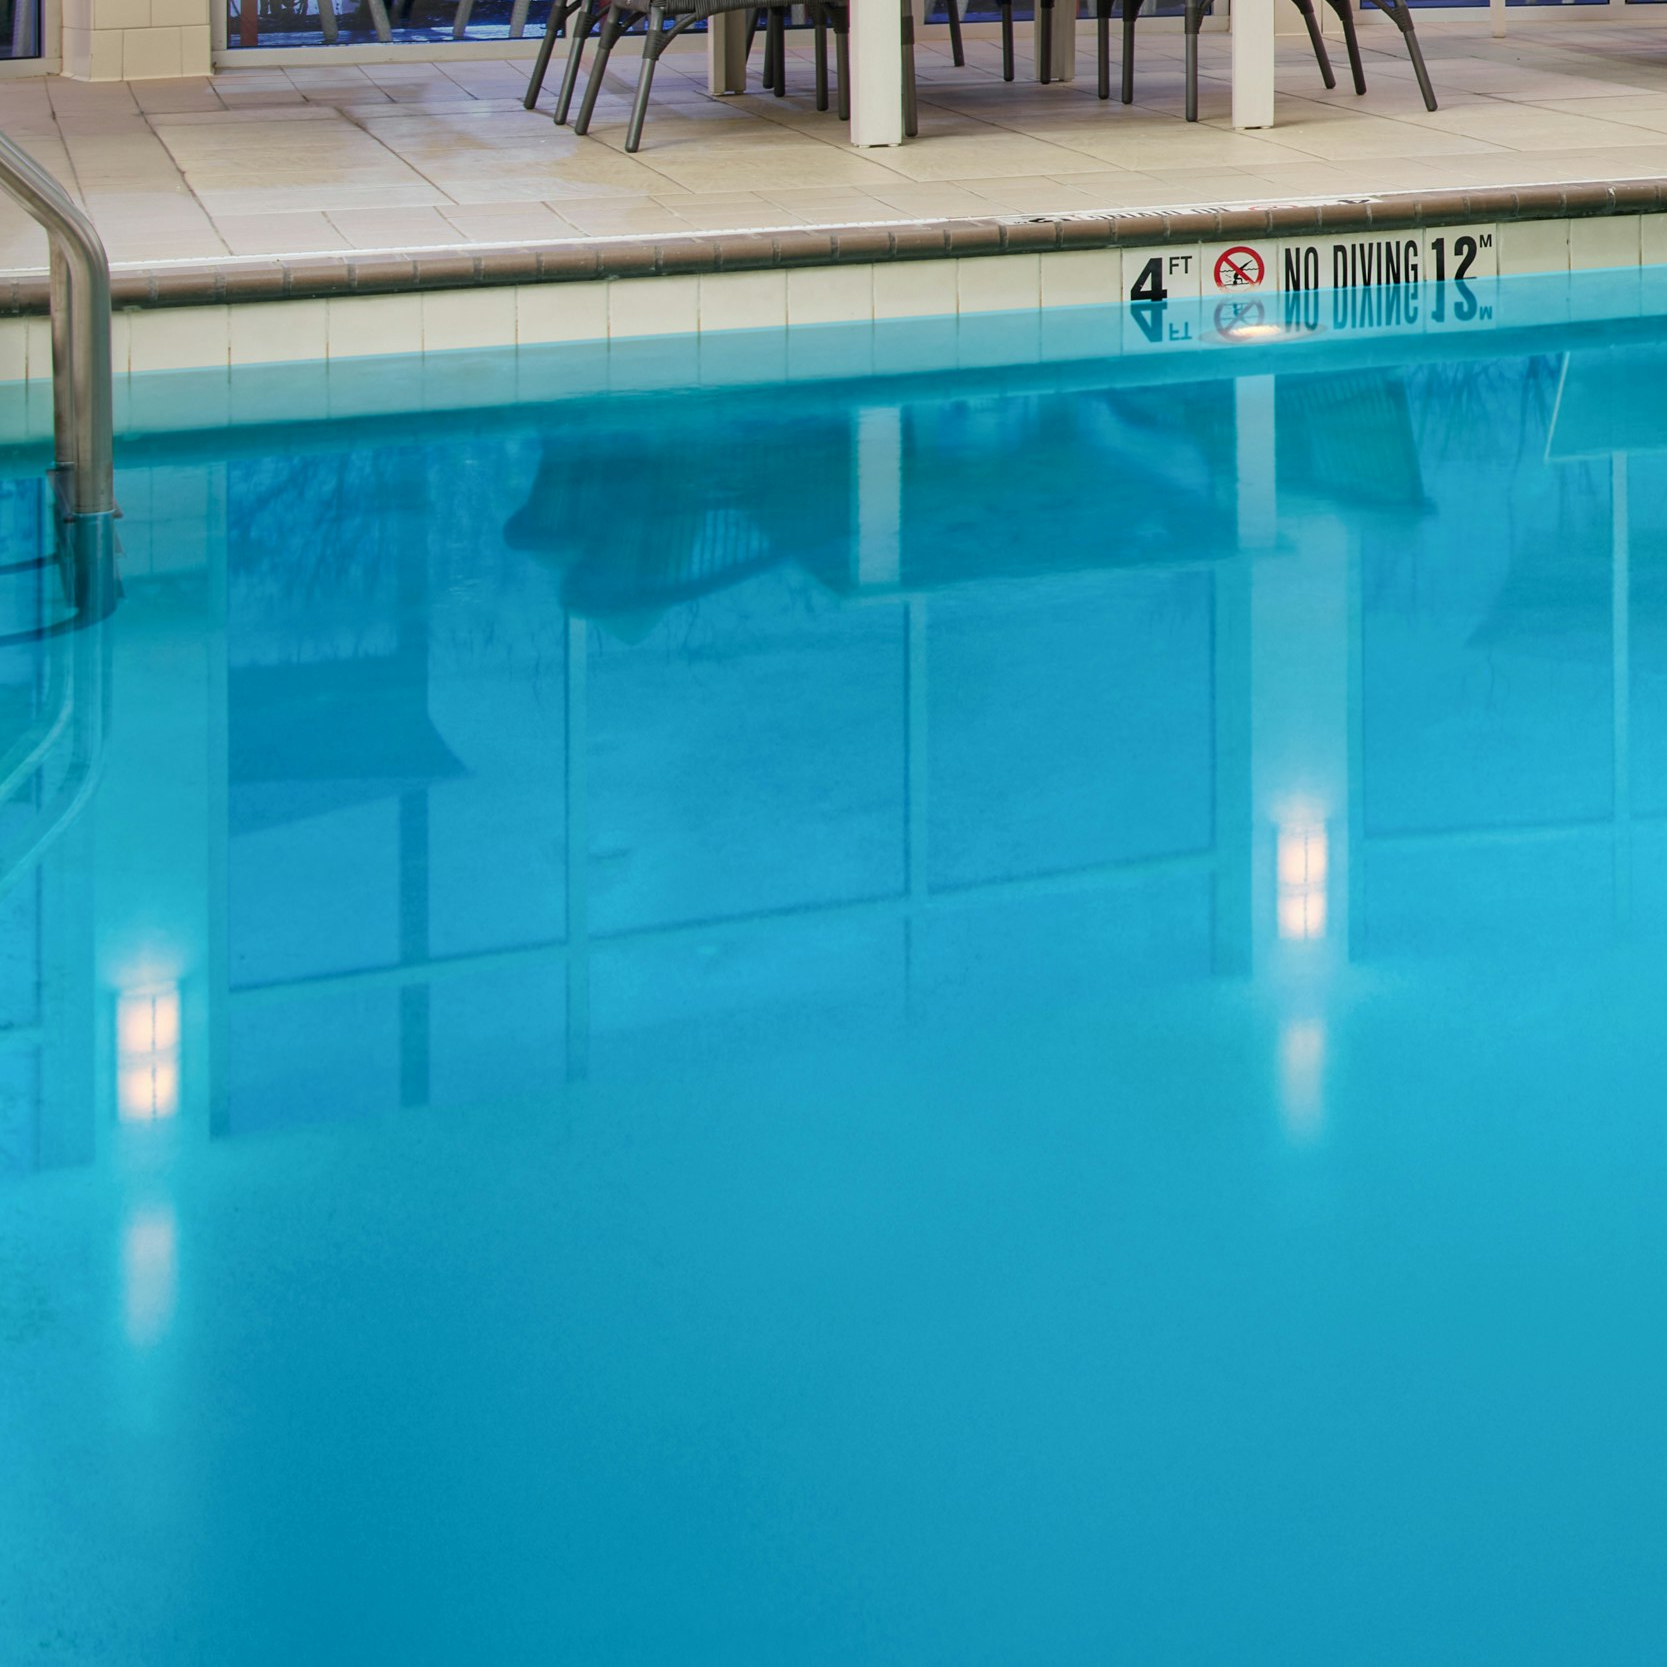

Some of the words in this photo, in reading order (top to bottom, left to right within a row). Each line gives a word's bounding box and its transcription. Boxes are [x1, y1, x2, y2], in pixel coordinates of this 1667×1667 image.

[1131, 257, 1167, 301] 4
[1169, 255, 1192, 275] FT
[1284, 246, 1319, 292] NO
[1333, 240, 1418, 288] DIVING
[1431, 236, 1477, 282] 12
[1479, 234, 1492, 248] M
